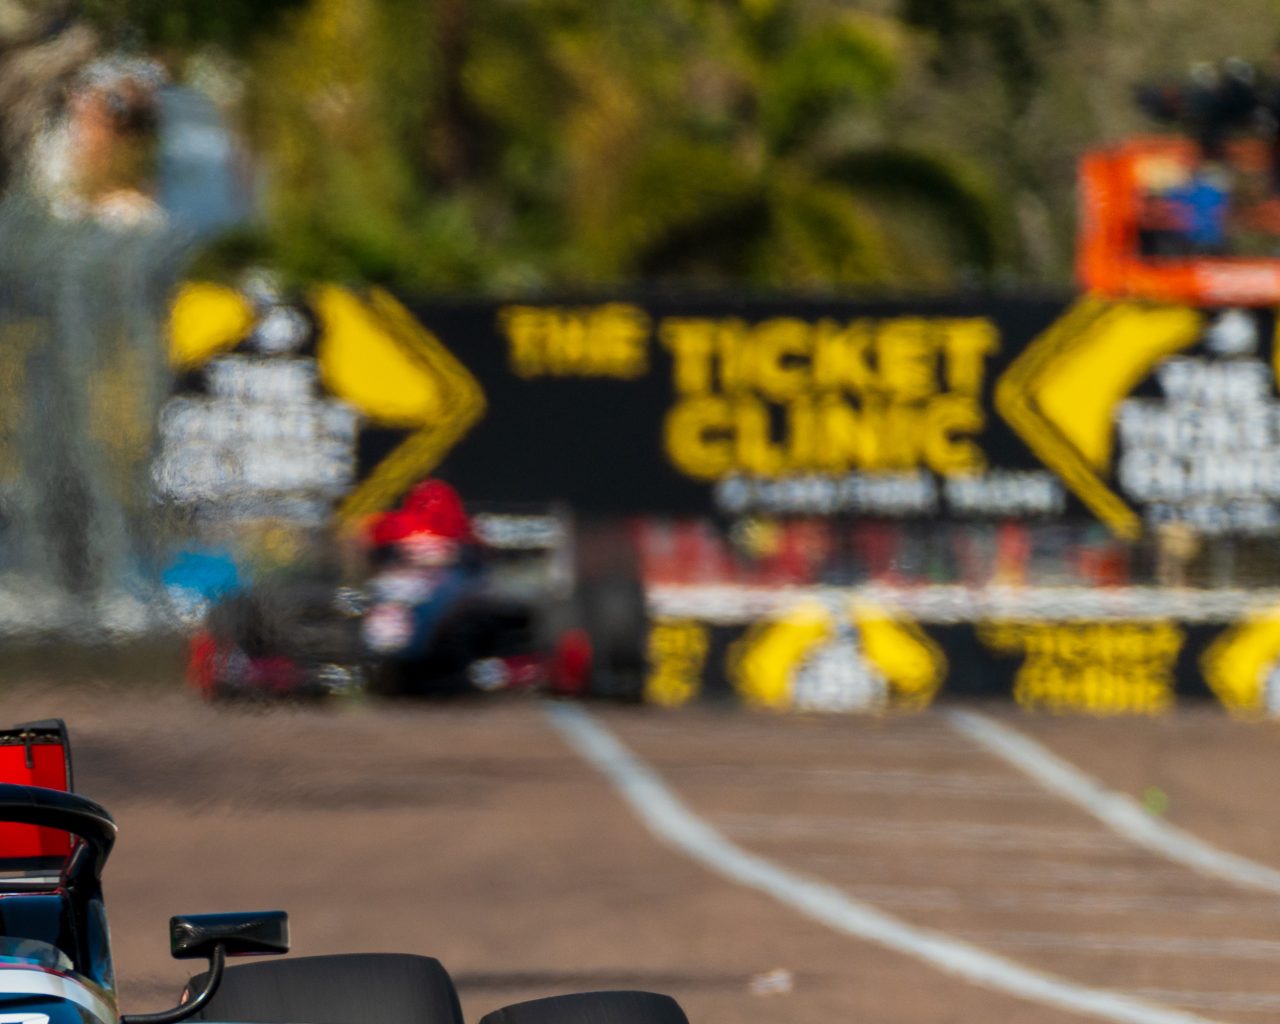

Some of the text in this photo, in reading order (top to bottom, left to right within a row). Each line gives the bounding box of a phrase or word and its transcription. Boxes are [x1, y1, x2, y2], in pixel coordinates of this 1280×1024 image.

[501, 304, 999, 398] THE TICKET
[665, 396, 987, 479] CLINIC
